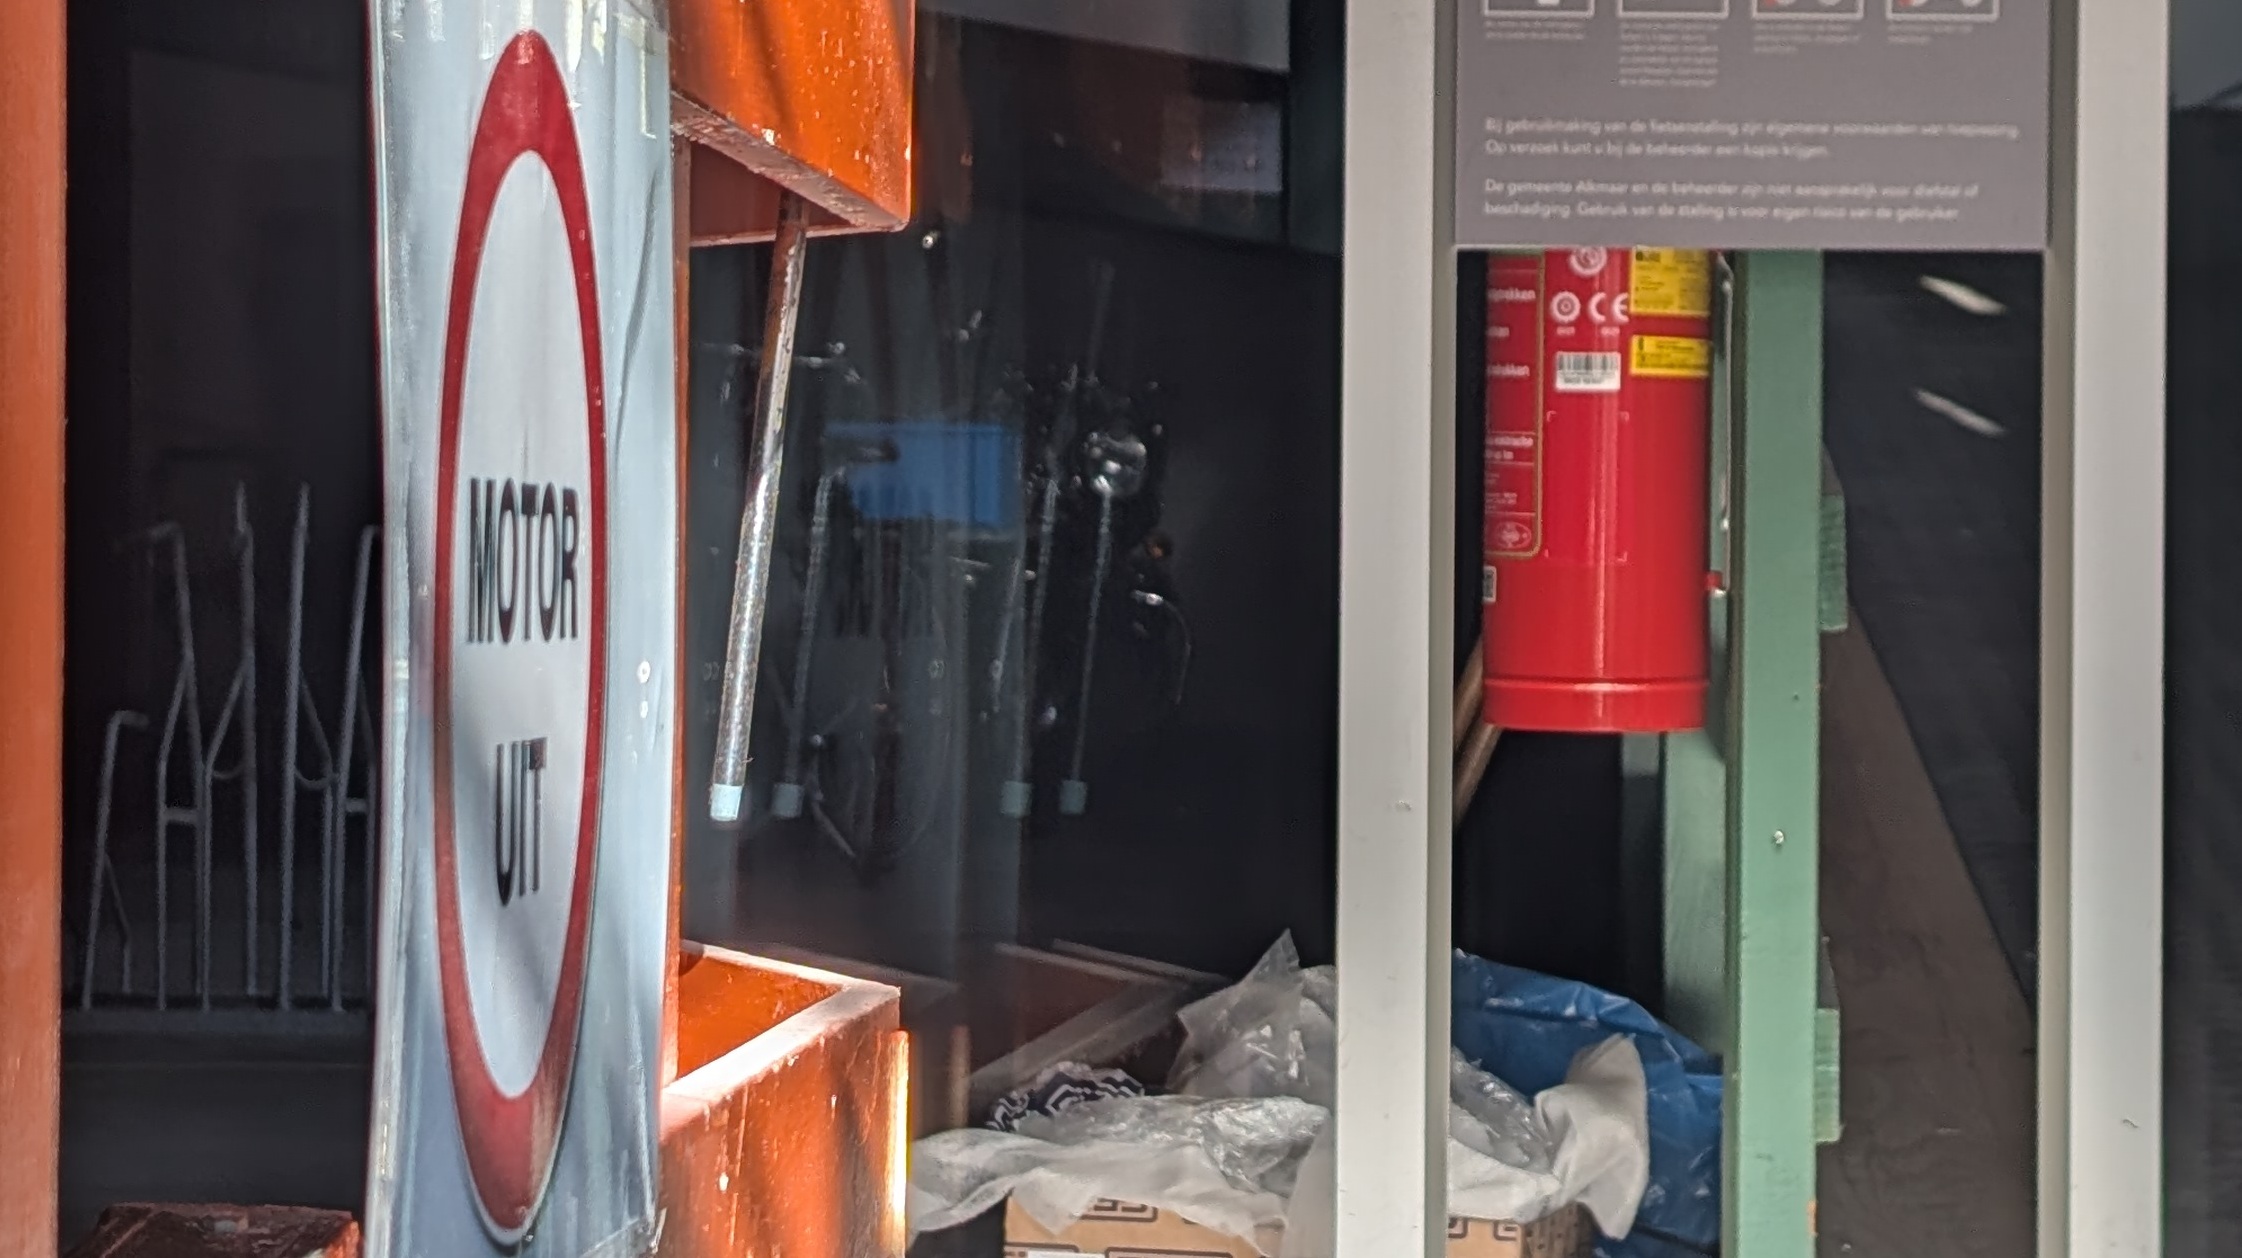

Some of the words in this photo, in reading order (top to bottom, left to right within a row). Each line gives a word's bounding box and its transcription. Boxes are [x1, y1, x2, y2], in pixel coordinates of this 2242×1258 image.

[1604, 122, 1627, 133] van
[1509, 140, 1559, 155] verzoek
[1562, 141, 1591, 156] kunt
[1645, 142, 1712, 156] beheerder
[1715, 145, 1740, 157] een
[1506, 180, 1572, 198] gemeente
[1575, 181, 1627, 195] Alkmaar
[1671, 182, 1738, 196] beheerder
[1766, 183, 1791, 197] niet
[1880, 187, 1911, 198] voor
[1577, 203, 1627, 217] Gebruik
[1631, 206, 1654, 218] van
[1849, 208, 1873, 219] van
[468, 478, 580, 644] MOTOR
[494, 737, 547, 906] UIT
